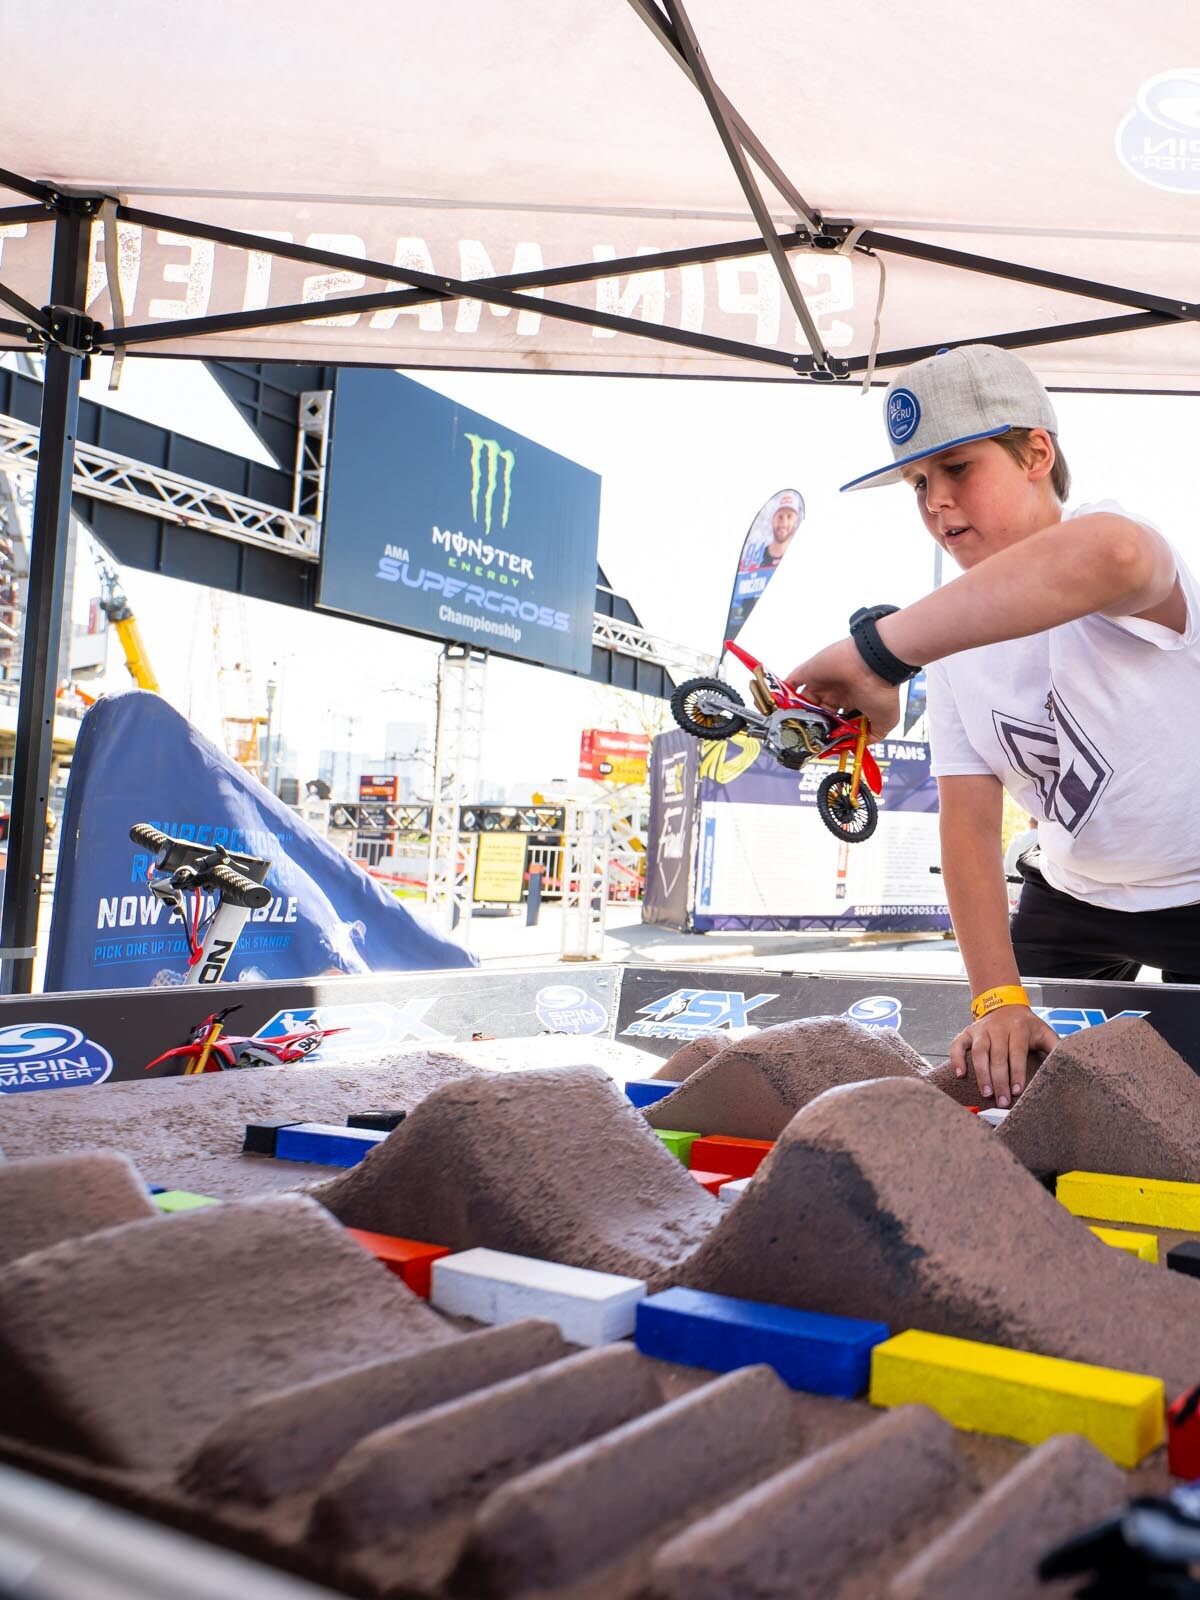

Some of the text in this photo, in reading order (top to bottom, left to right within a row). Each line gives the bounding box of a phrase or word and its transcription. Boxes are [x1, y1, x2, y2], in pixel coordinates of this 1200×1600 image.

[384, 544, 410, 563] AMA
[432, 526, 534, 580] MONSTER
[448, 557, 519, 588] ENERGY
[375, 557, 571, 634] SUPERCROSS
[438, 604, 522, 642] Championship
[888, 744, 926, 761] FANS
[97, 896, 163, 929] NOW
[853, 906, 950, 917] SUPERMOTOCROSS.CO
[94, 945, 121, 961] PICK
[126, 942, 148, 957] ONE
[151, 940, 166, 955] UP
[253, 936, 291, 949] STANDS
[299, 1038, 318, 1052] 94
[0, 1054, 89, 1075] SPIN
